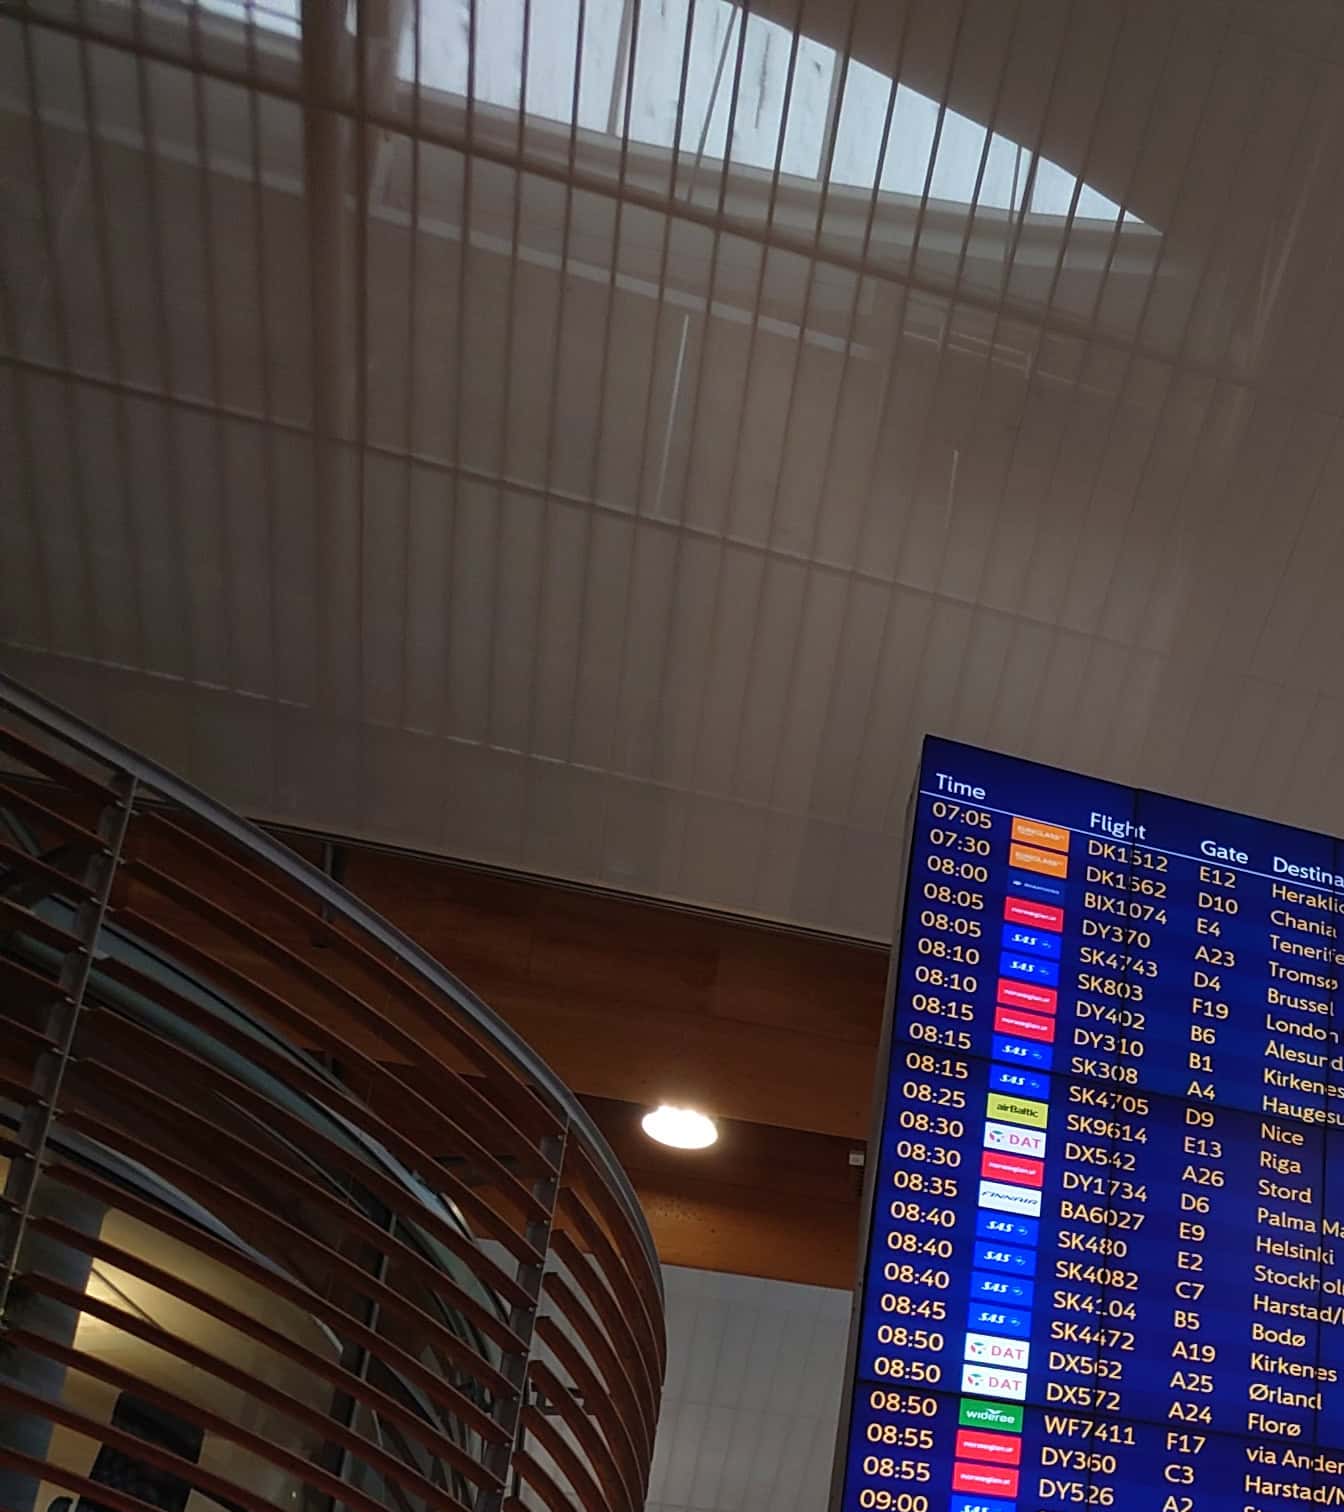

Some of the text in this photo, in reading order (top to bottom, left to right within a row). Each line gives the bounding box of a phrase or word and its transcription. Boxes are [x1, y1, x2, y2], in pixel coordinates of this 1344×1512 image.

[935, 772, 986, 800] Time
[1090, 812, 1146, 840] Flight
[1200, 840, 1249, 865] Gate
[927, 855, 988, 883] 08:00
[1084, 891, 1168, 925] BIX1074
[1197, 917, 1221, 937] E4
[918, 937, 980, 965] 08:10
[1077, 973, 1143, 1001] SK803
[1192, 997, 1229, 1020] F19
[1266, 1013, 1339, 1044] London
[903, 1081, 1302, 1175] 08:25 airBaltic SK9614 E13 Riga
[906, 1052, 1304, 1146] 08:15 SK4705 D9 Nice
[1009, 1134, 1041, 1149] DAT
[896, 1140, 961, 1168] 08:30
[1062, 1171, 1148, 1203] DY1734
[1180, 1192, 1210, 1214] D6
[1257, 1207, 1317, 1233] Palma
[986, 1220, 1014, 1233] SAS
[887, 1231, 953, 1258] 08:40
[1055, 1260, 1139, 1291] SK4082
[1175, 1281, 1205, 1301] C7
[978, 1312, 1006, 1324] SAS
[991, 1345, 1025, 1361] DAT
[870, 1390, 938, 1417] 08:50
[1044, 1414, 1136, 1445] WF7411
[1166, 1432, 1206, 1454] F17
[1246, 1445, 1277, 1465] via
